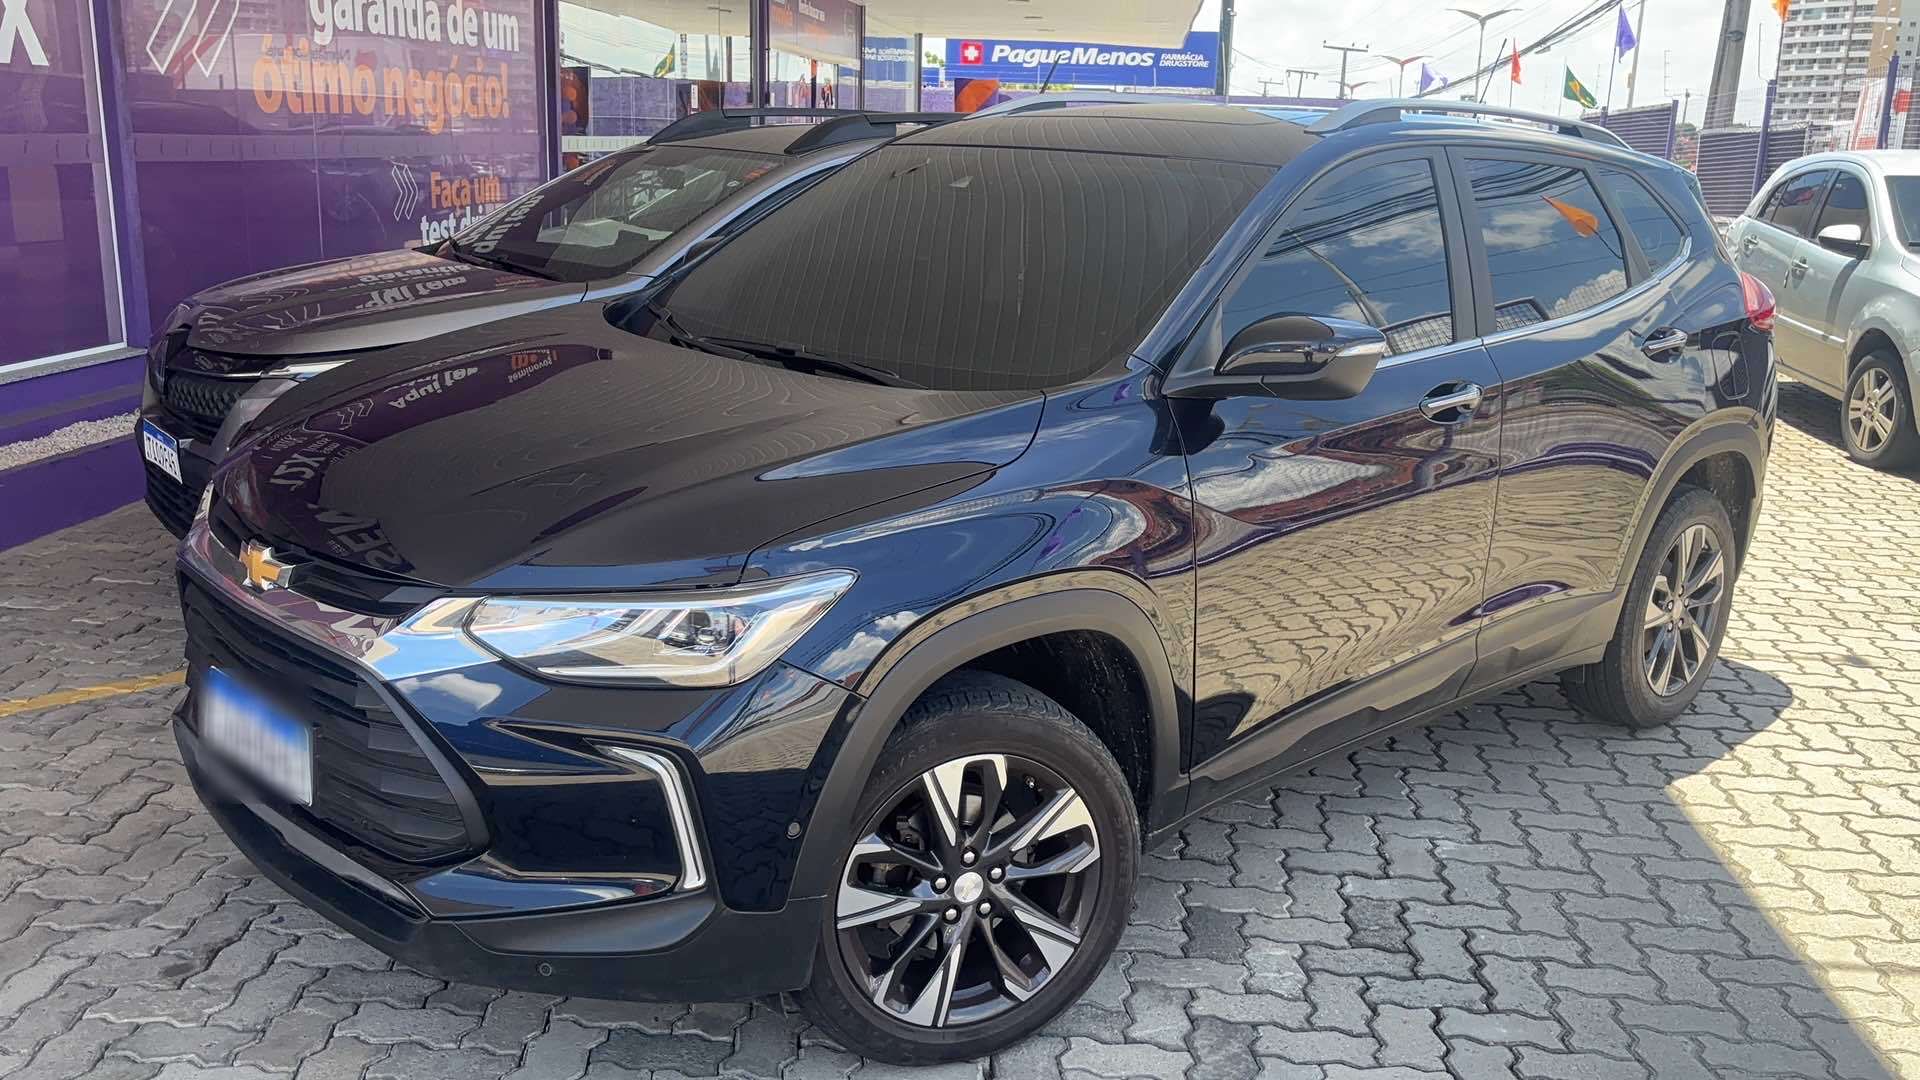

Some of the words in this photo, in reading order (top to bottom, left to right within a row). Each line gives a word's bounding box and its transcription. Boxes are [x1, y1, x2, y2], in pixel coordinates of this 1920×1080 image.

[310, 0, 441, 45] garantia
[447, 0, 478, 47] de
[484, 10, 520, 51] um
[991, 44, 1154, 69] PagueMenos
[1159, 60, 1210, 68] DRUGSTORE
[1160, 51, 1204, 61] FARMÁCIA
[253, 34, 377, 116] ótimo
[384, 55, 510, 135] negócio!
[430, 172, 471, 217] Faça
[474, 174, 501, 205] um
[420, 212, 456, 247] test
